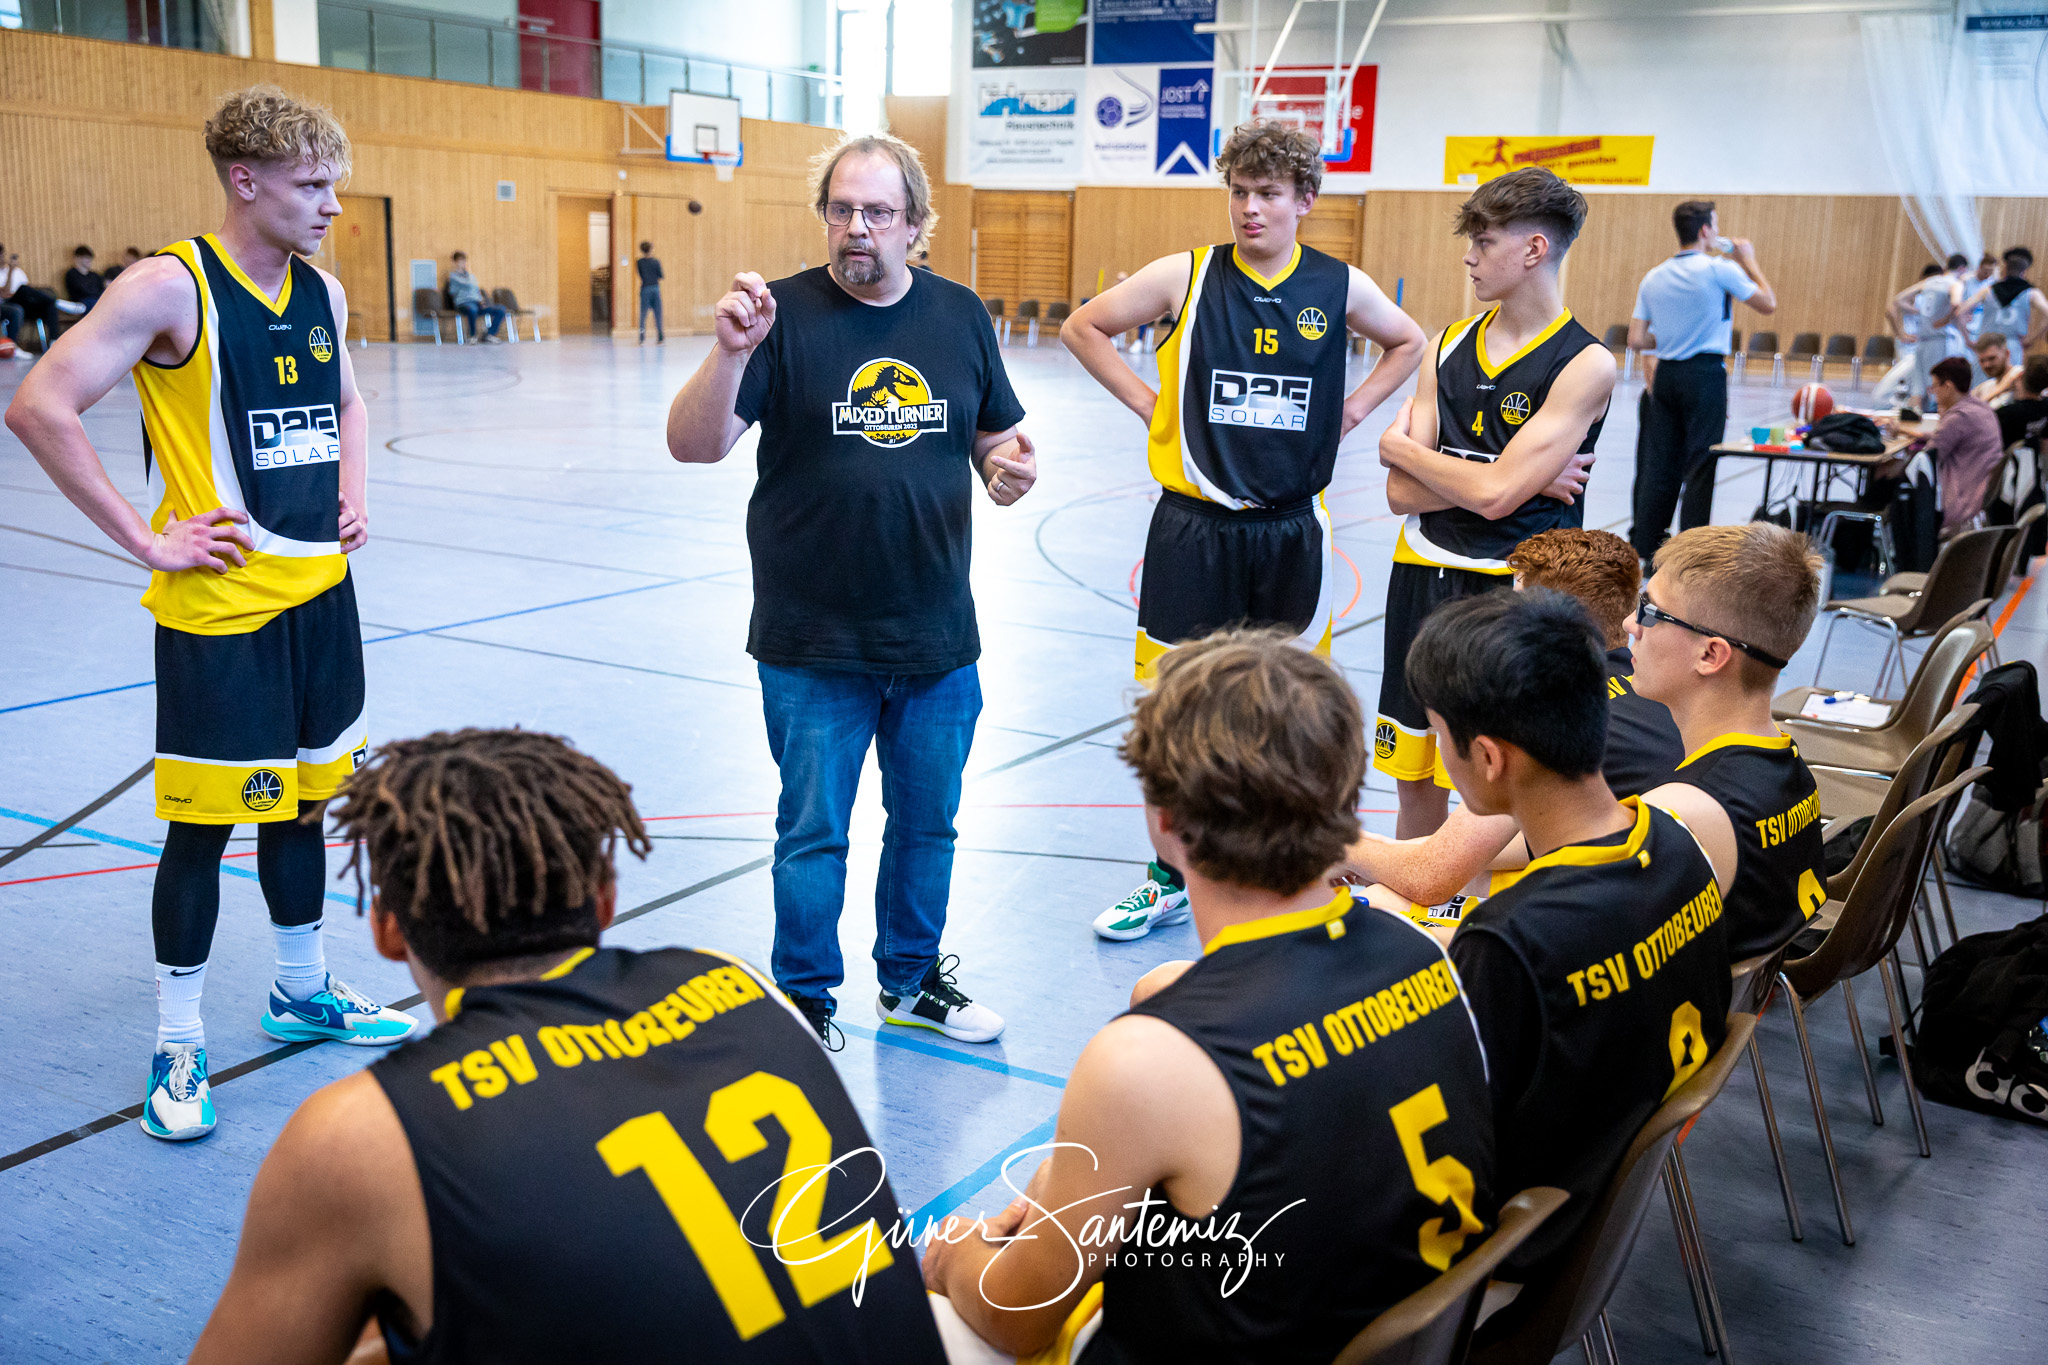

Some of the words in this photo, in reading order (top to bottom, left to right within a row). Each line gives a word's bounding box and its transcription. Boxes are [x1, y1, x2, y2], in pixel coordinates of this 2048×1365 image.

[1253, 328, 1279, 355] 15
[274, 355, 299, 385] 13
[1213, 372, 1310, 412] D2E
[251, 406, 339, 450] D2E
[1211, 407, 1306, 429] SOLAR
[1471, 411, 1484, 437] 4
[1755, 812, 1786, 849] TSV
[1566, 952, 1631, 1007] TSV
[1632, 877, 1723, 980] OTTOBEUREN
[430, 1034, 539, 1111] TSV
[537, 964, 766, 1068] OTTOBEUREN
[1252, 1022, 1329, 1087] TSV
[1322, 958, 1460, 1056] OTTOBEUREN
[1388, 1082, 1485, 1273] 5
[596, 1070, 895, 1341] 12
